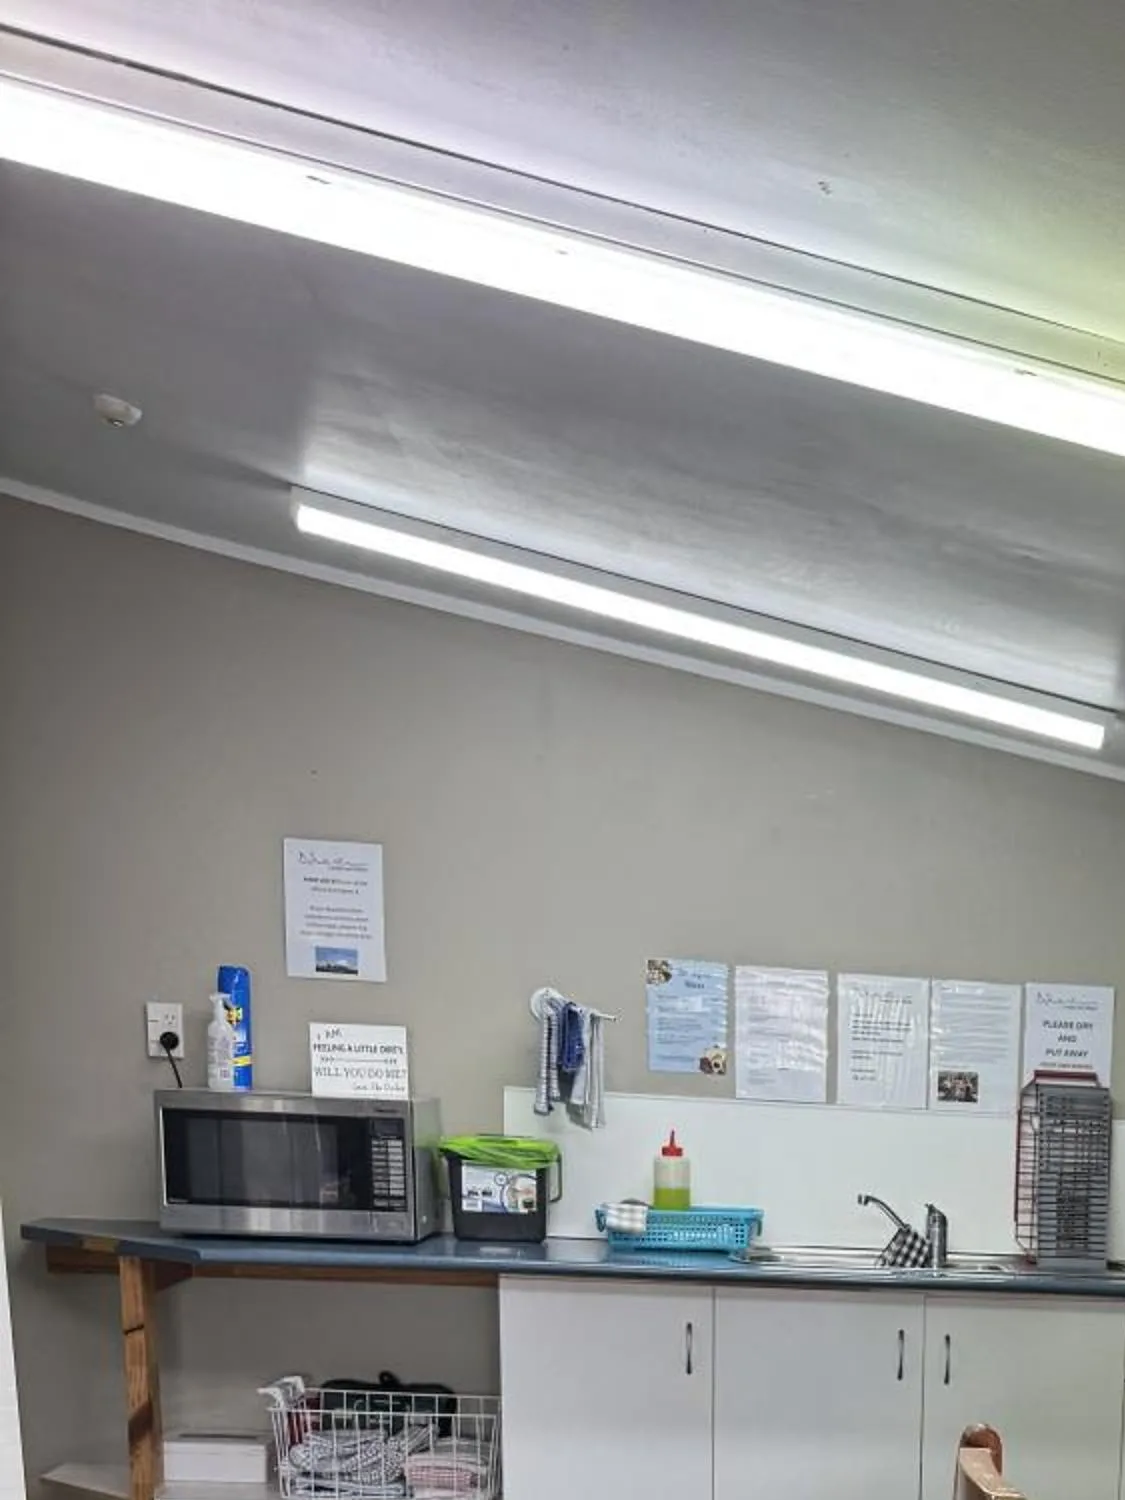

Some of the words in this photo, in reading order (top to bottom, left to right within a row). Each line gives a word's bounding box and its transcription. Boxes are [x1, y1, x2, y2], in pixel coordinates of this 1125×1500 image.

[1042, 1020, 1074, 1029] PLEASE
[1075, 1021, 1093, 1030] DRY
[1057, 1034, 1077, 1043] AND
[313, 1043, 346, 1053] FEELING
[354, 1044, 378, 1054] LITTLE
[1046, 1048, 1062, 1057] PUT
[1063, 1049, 1089, 1058] AWAY
[314, 1066, 342, 1077] WILL
[343, 1067, 367, 1079] YOU
[367, 1067, 384, 1079] DO
